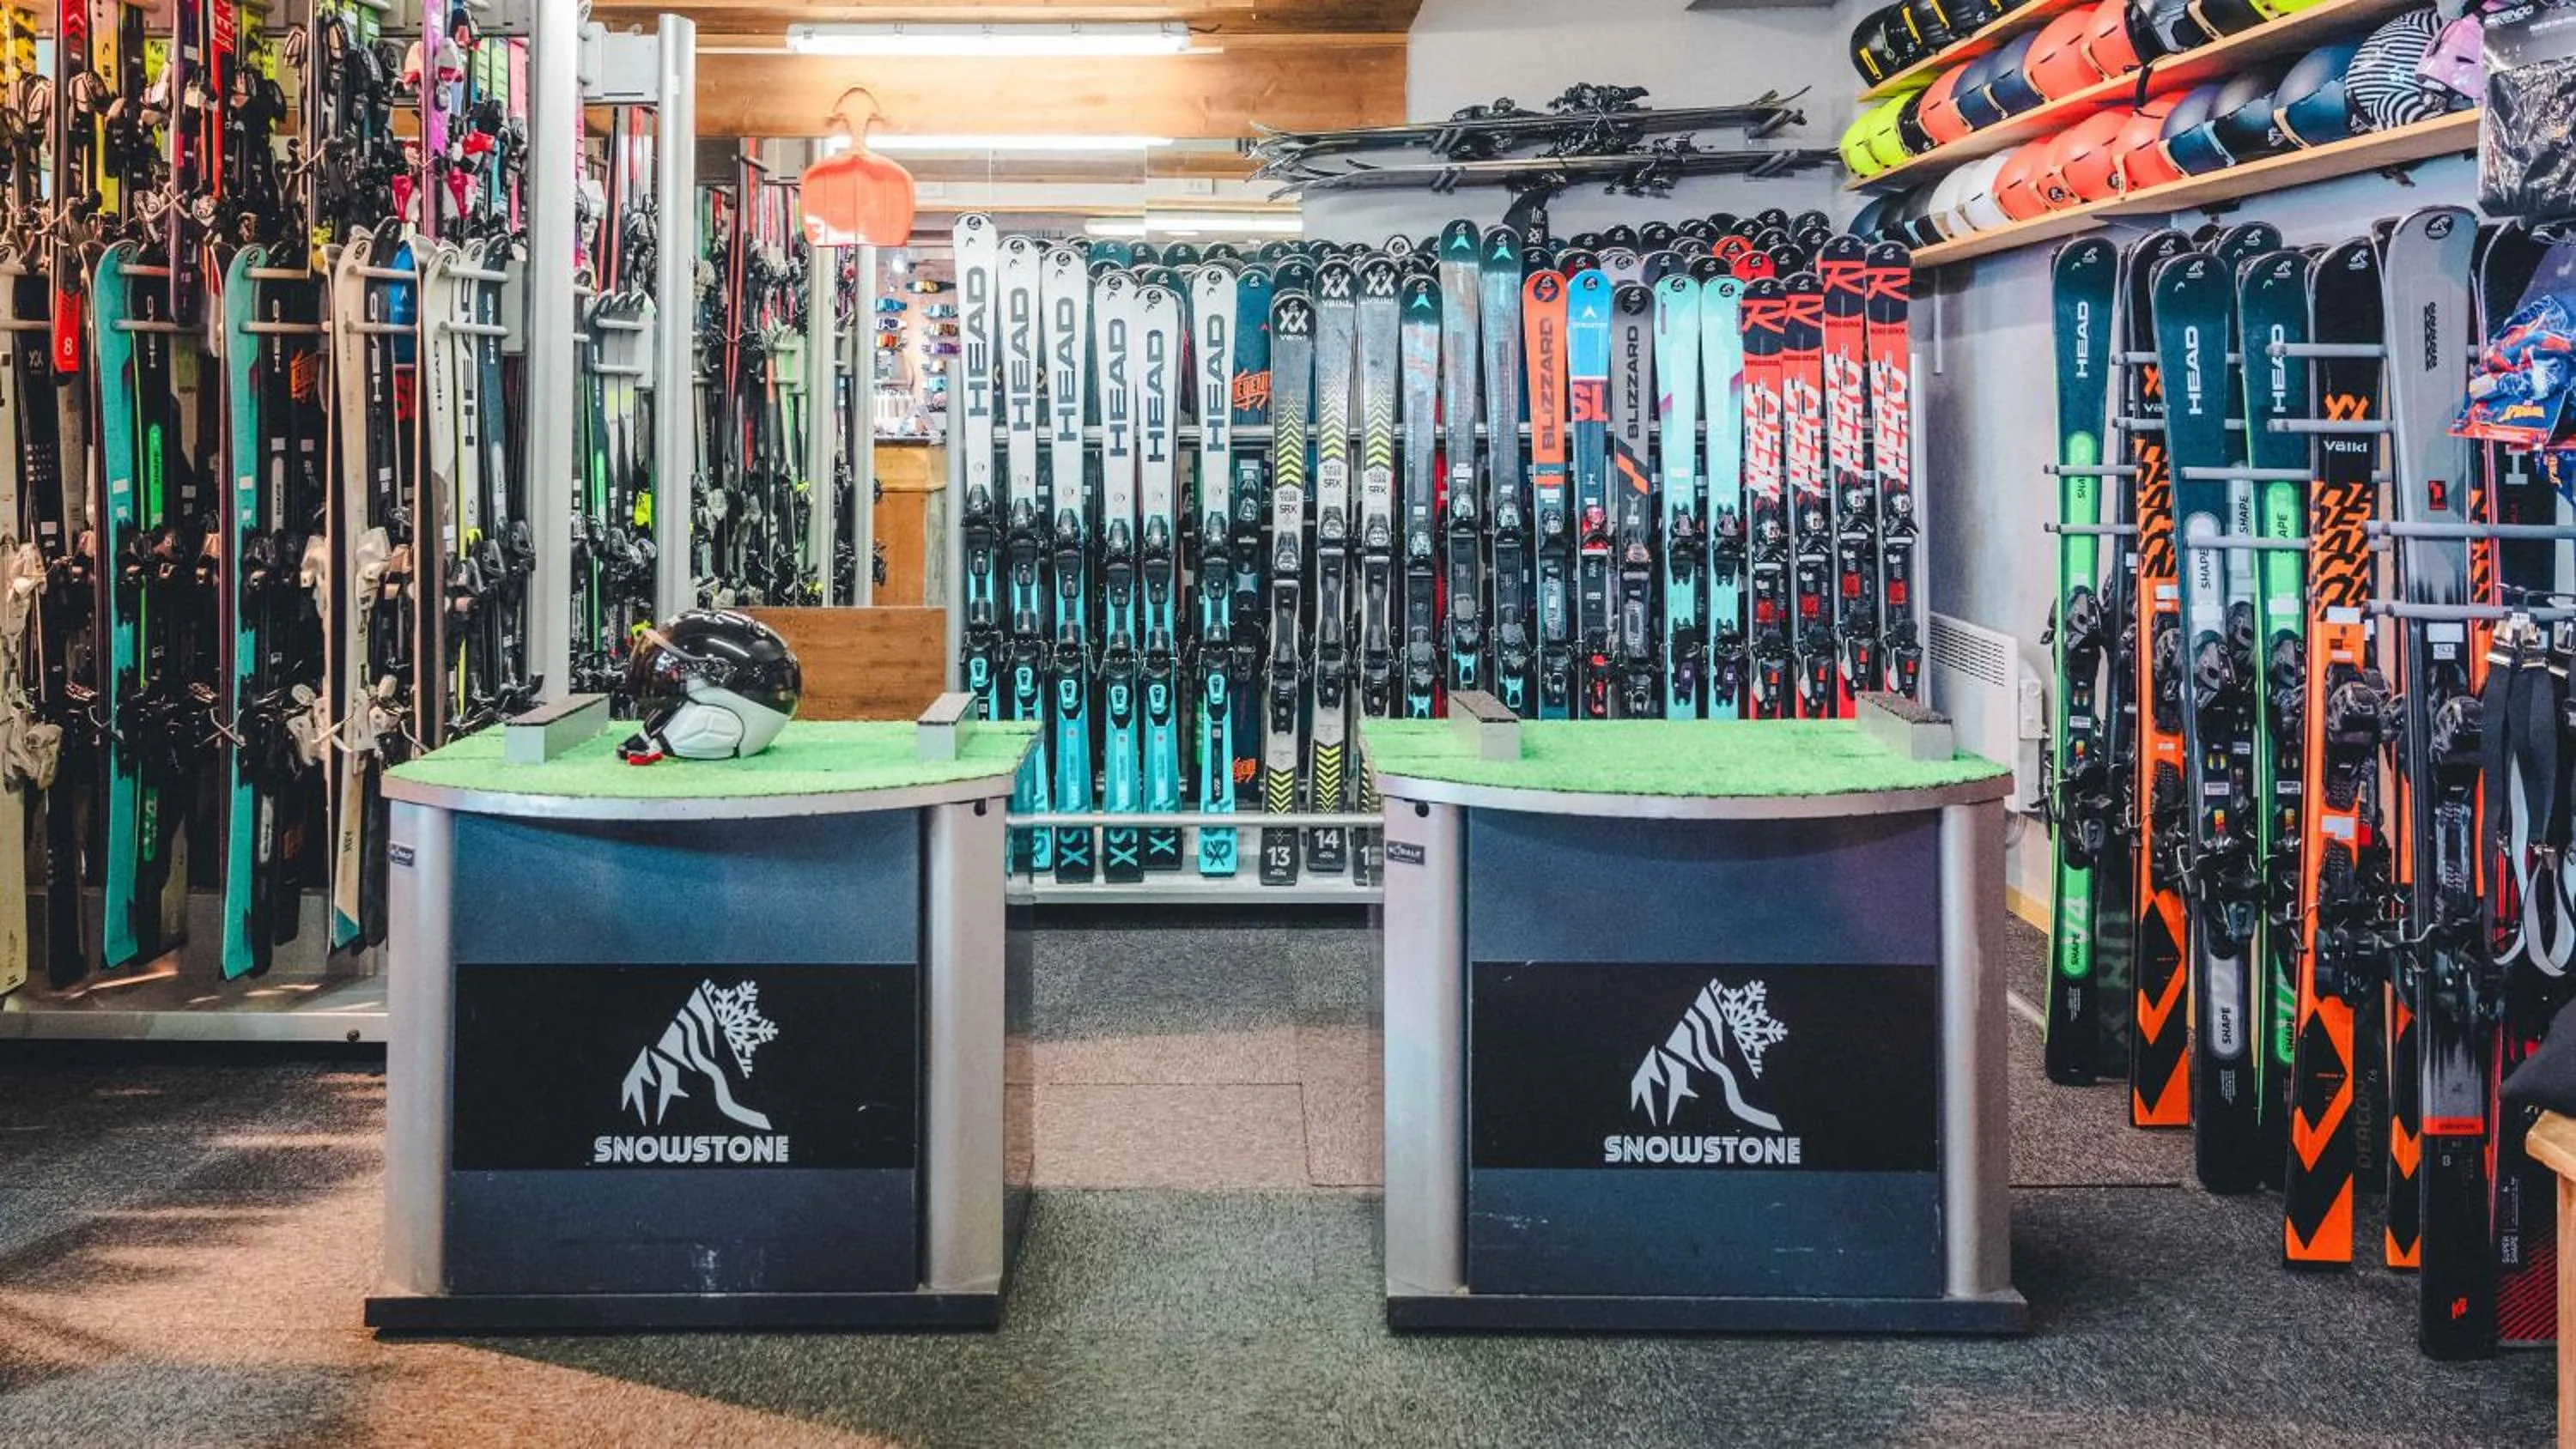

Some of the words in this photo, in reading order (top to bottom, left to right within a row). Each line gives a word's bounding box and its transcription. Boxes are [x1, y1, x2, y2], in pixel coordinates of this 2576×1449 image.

[64, 336, 73, 356] 8
[967, 265, 988, 417] HEAD
[1011, 288, 1031, 432] HEAD
[1056, 296, 1077, 442] HEAD
[2075, 300, 2089, 379] HEAD
[1109, 318, 1127, 458] HEAD
[1146, 329, 1165, 463] HEAD
[1206, 313, 1226, 452] HEAD
[1539, 318, 1556, 452] BLIZZARD
[1627, 325, 1639, 440] BLIZZARD
[2184, 325, 2203, 415] HEAD
[2076, 475, 2087, 499] SHA
[2239, 494, 2249, 534] SHAPE
[2198, 548, 2211, 590] SHAPE
[1267, 845, 1291, 867] 13
[1315, 829, 1340, 850] 14
[2070, 933, 2081, 967] SHAPE
[2221, 1007, 2232, 1045] SHAPE
[593, 1135, 789, 1162] SNOWSTONE
[1603, 1135, 1801, 1164] SNOWSTONE
